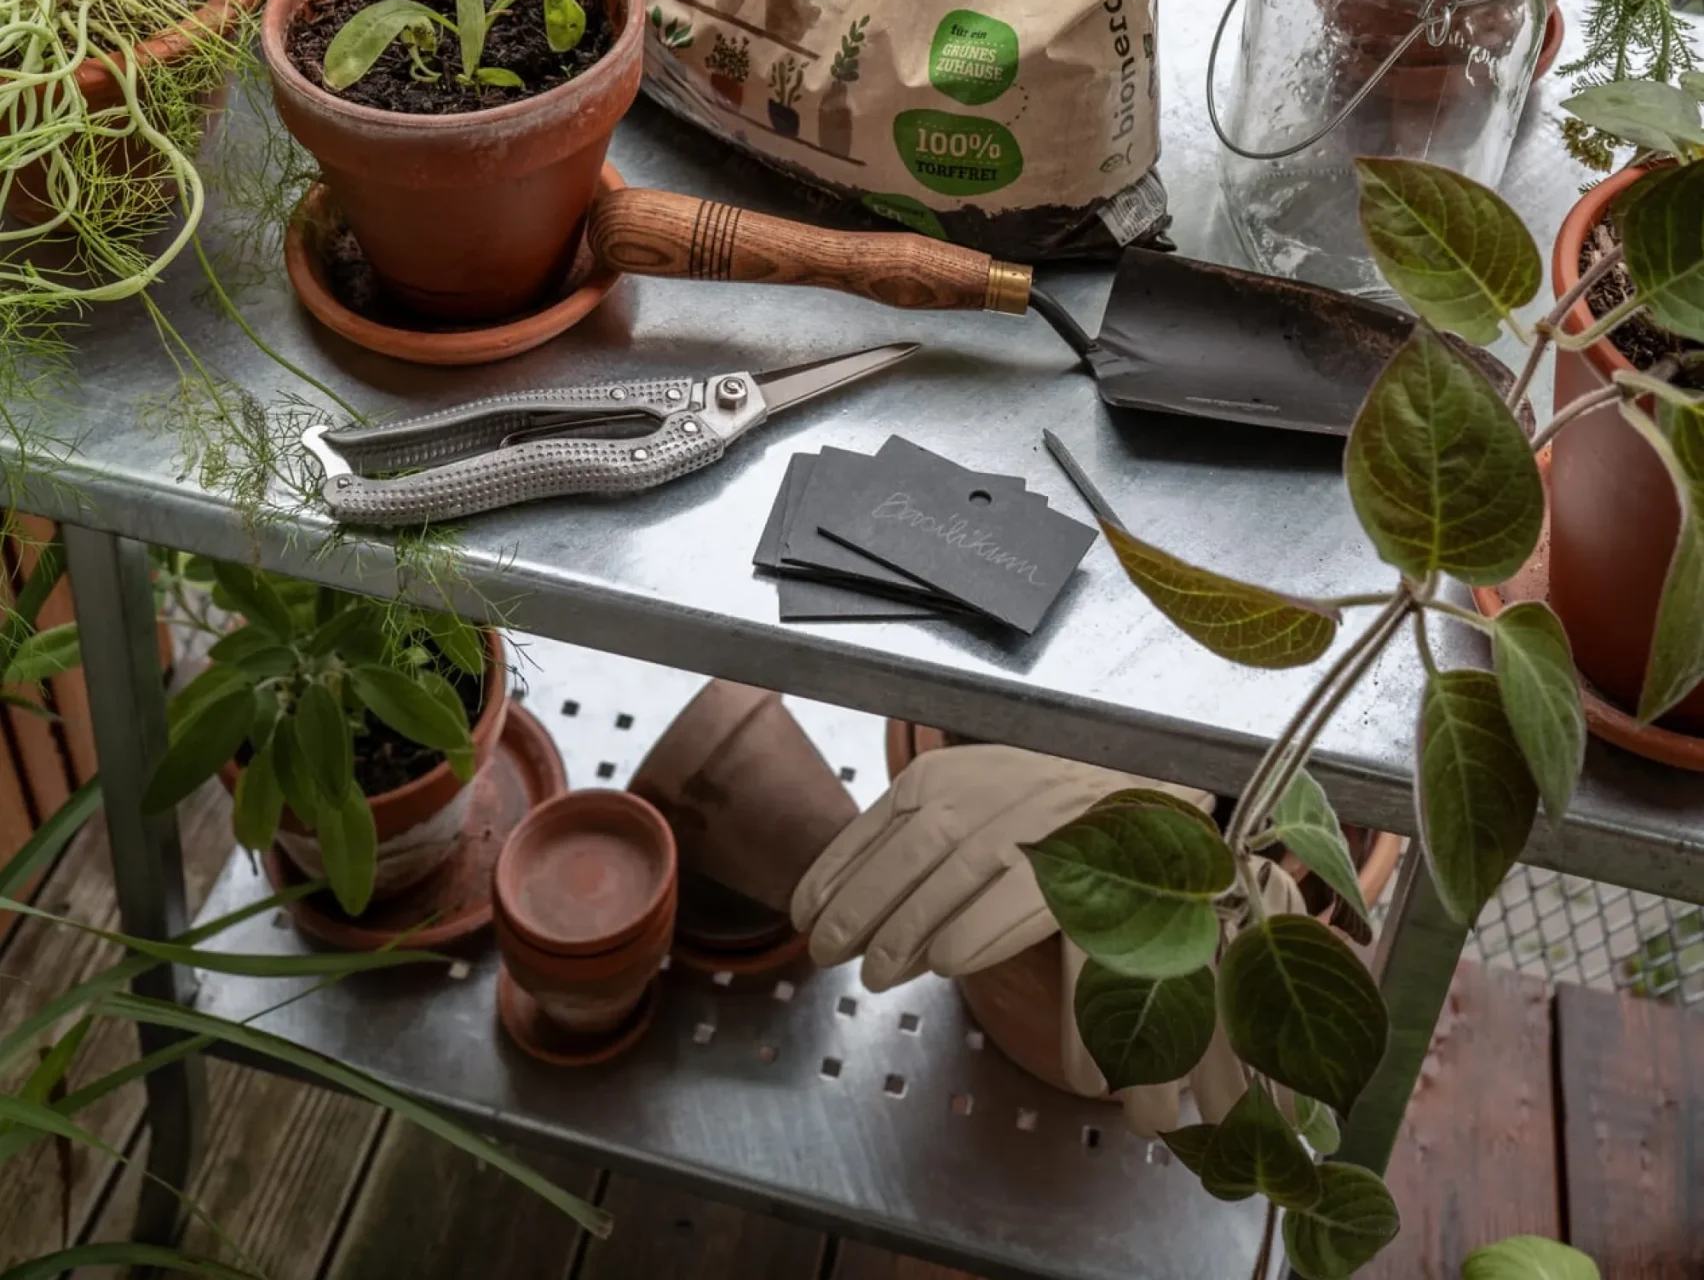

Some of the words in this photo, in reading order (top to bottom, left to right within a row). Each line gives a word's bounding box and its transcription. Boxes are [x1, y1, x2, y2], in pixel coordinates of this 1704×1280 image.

[935, 57, 1004, 81] ZUHAUSE
[915, 128, 1001, 159] 100%
[915, 160, 998, 181] TORFFREI
